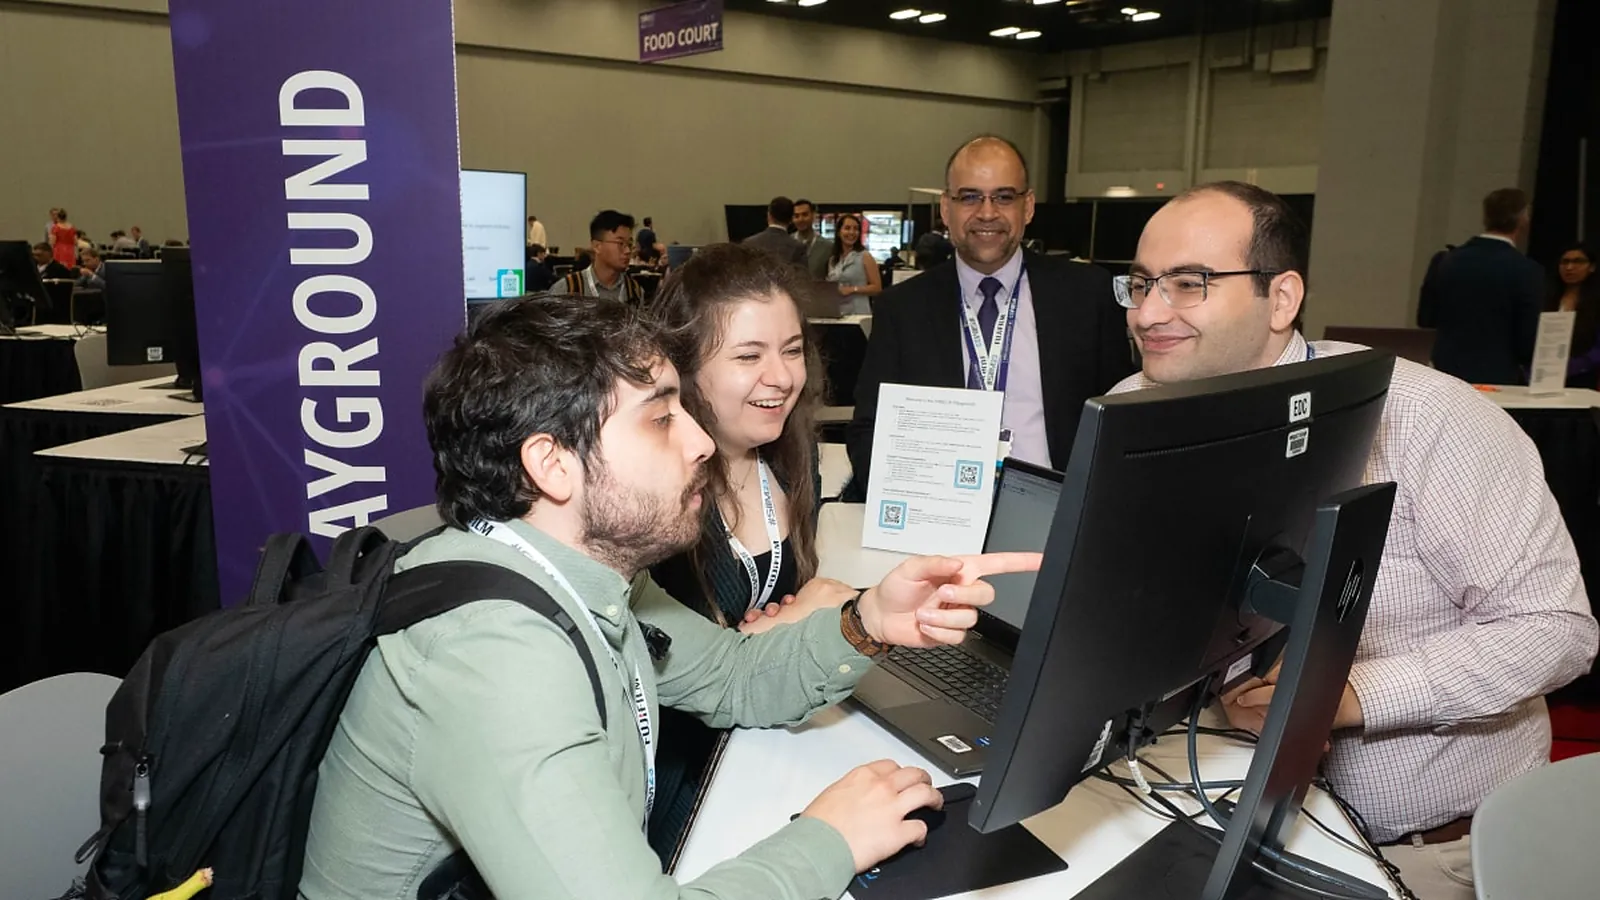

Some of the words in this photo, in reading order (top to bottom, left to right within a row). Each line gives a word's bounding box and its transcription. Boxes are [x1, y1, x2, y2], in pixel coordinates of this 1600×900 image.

[644, 31, 675, 52] FOOD
[678, 22, 719, 46] COURT
[1293, 398, 1308, 416] EDC
[768, 540, 780, 588] FUJIFILM
